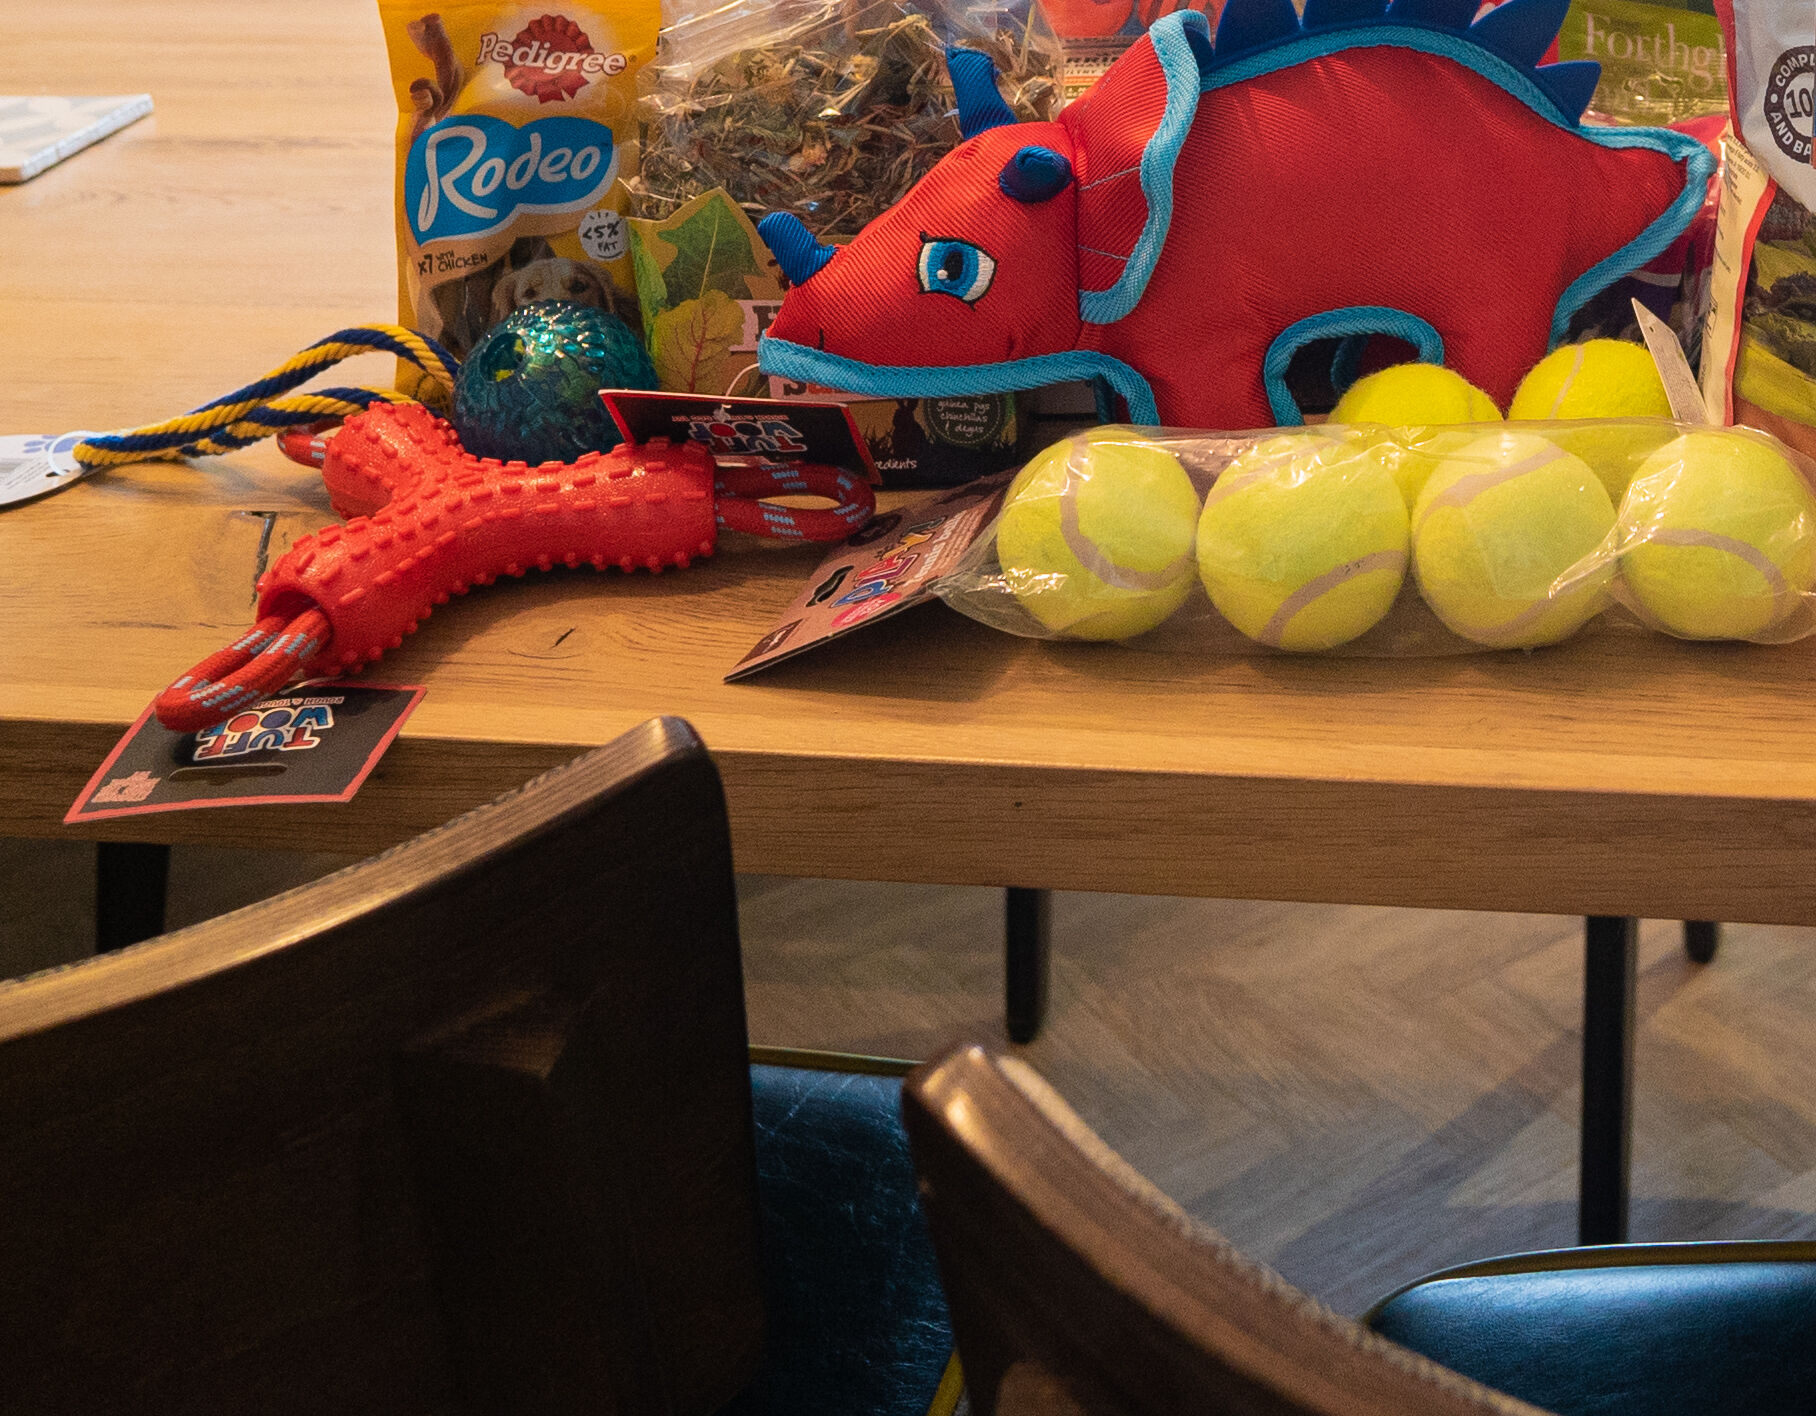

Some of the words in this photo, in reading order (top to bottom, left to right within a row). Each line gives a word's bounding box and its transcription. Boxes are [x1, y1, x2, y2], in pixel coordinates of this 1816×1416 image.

[476, 32, 627, 76] Pedigree
[1785, 87, 1815, 119] 10
[1769, 111, 1795, 146] AND
[418, 125, 601, 232] Rodeo
[437, 253, 488, 272] CHICKEN
[597, 241, 618, 252] FAT
[873, 458, 918, 470] redients
[193, 726, 322, 762] TUFF
